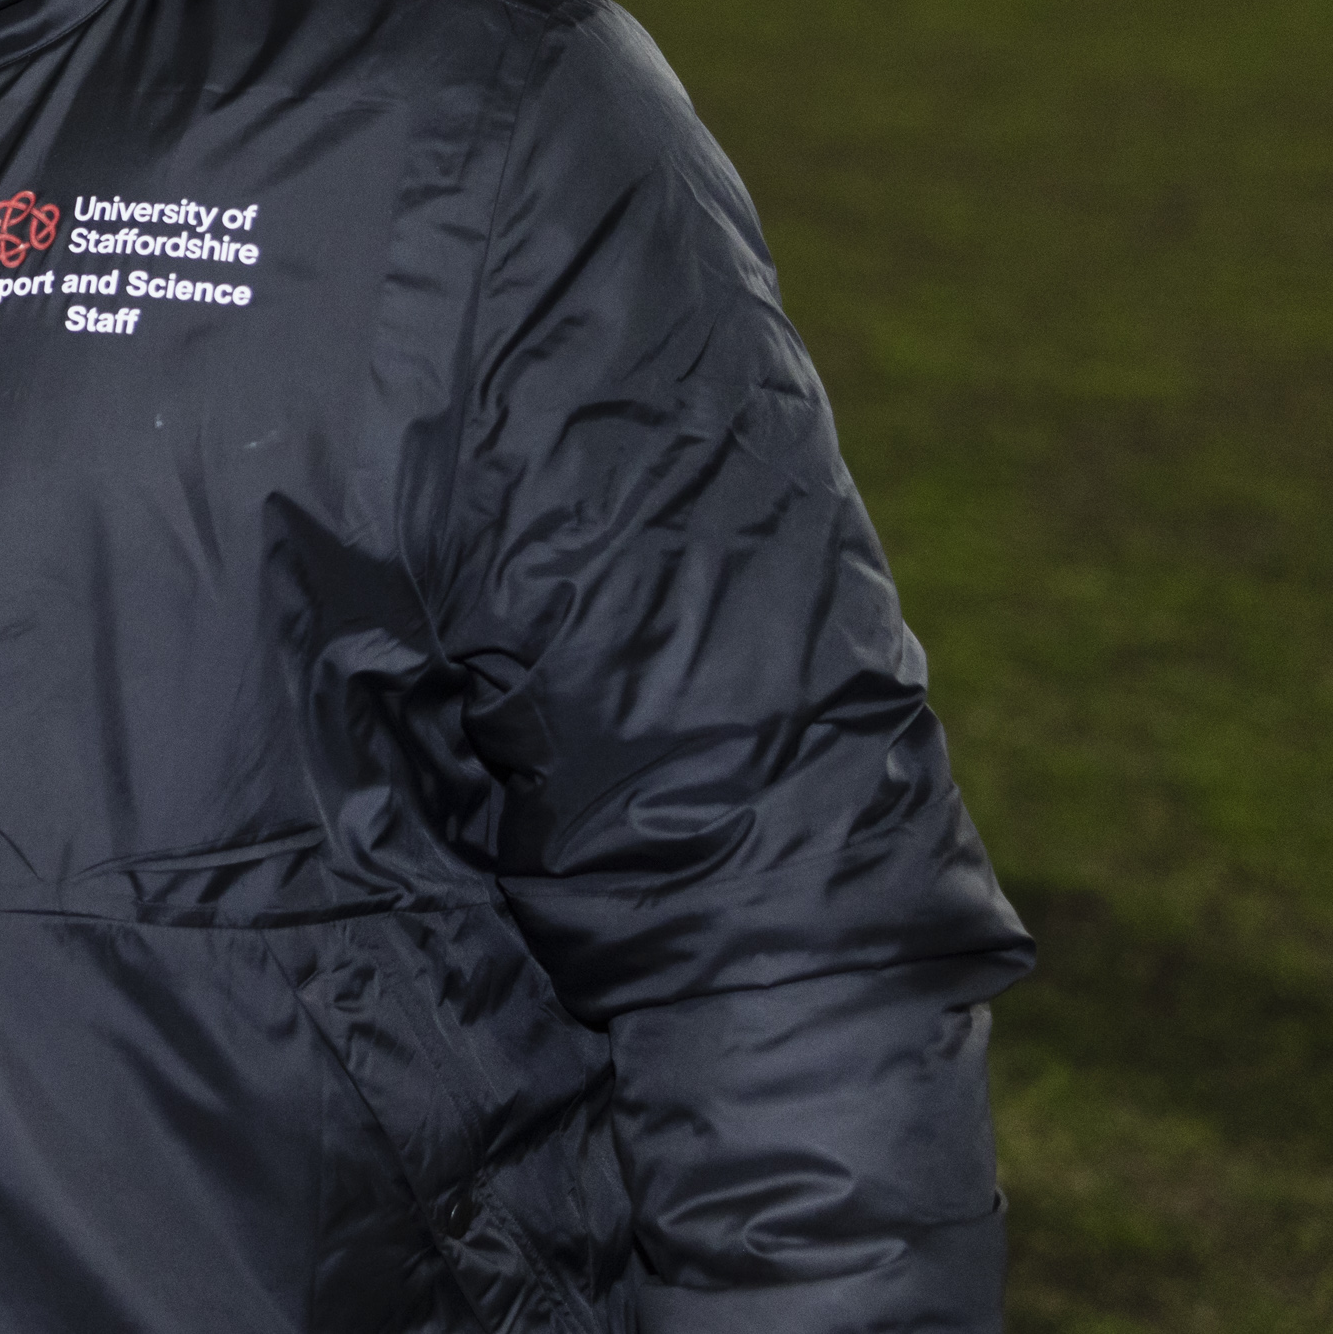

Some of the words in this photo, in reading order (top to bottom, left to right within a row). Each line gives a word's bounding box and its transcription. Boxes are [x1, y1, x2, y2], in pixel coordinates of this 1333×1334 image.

[73, 195, 218, 233] University
[222, 204, 259, 231] of
[68, 227, 260, 266] Staffordshire
[61, 269, 119, 295] and
[126, 270, 252, 306] Science
[64, 305, 141, 335] Staff
